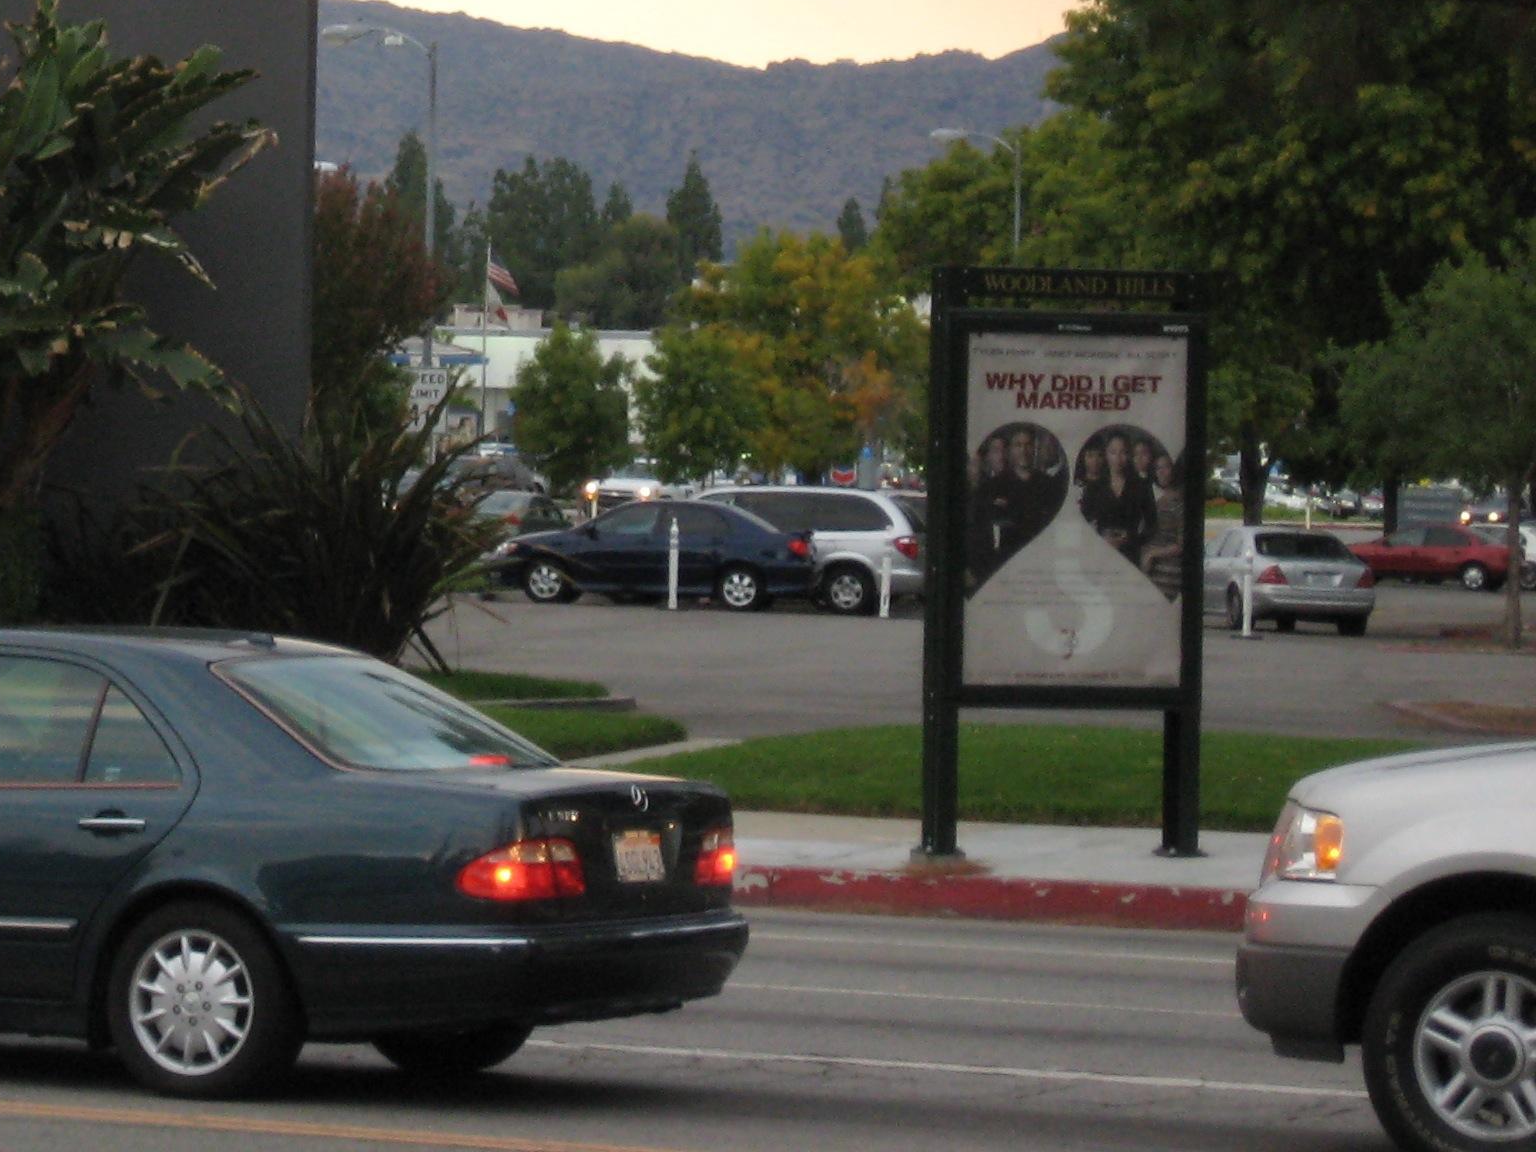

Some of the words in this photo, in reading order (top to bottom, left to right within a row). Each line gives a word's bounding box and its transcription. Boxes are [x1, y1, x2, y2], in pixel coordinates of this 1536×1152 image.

[983, 272, 1108, 295] WOODLAND
[1115, 276, 1177, 296] HILLS
[985, 372, 1046, 391] WHY
[1051, 374, 1093, 393] DID
[1099, 376, 1107, 393] I
[1112, 375, 1163, 394] GET
[1015, 392, 1132, 411] MARRIED
